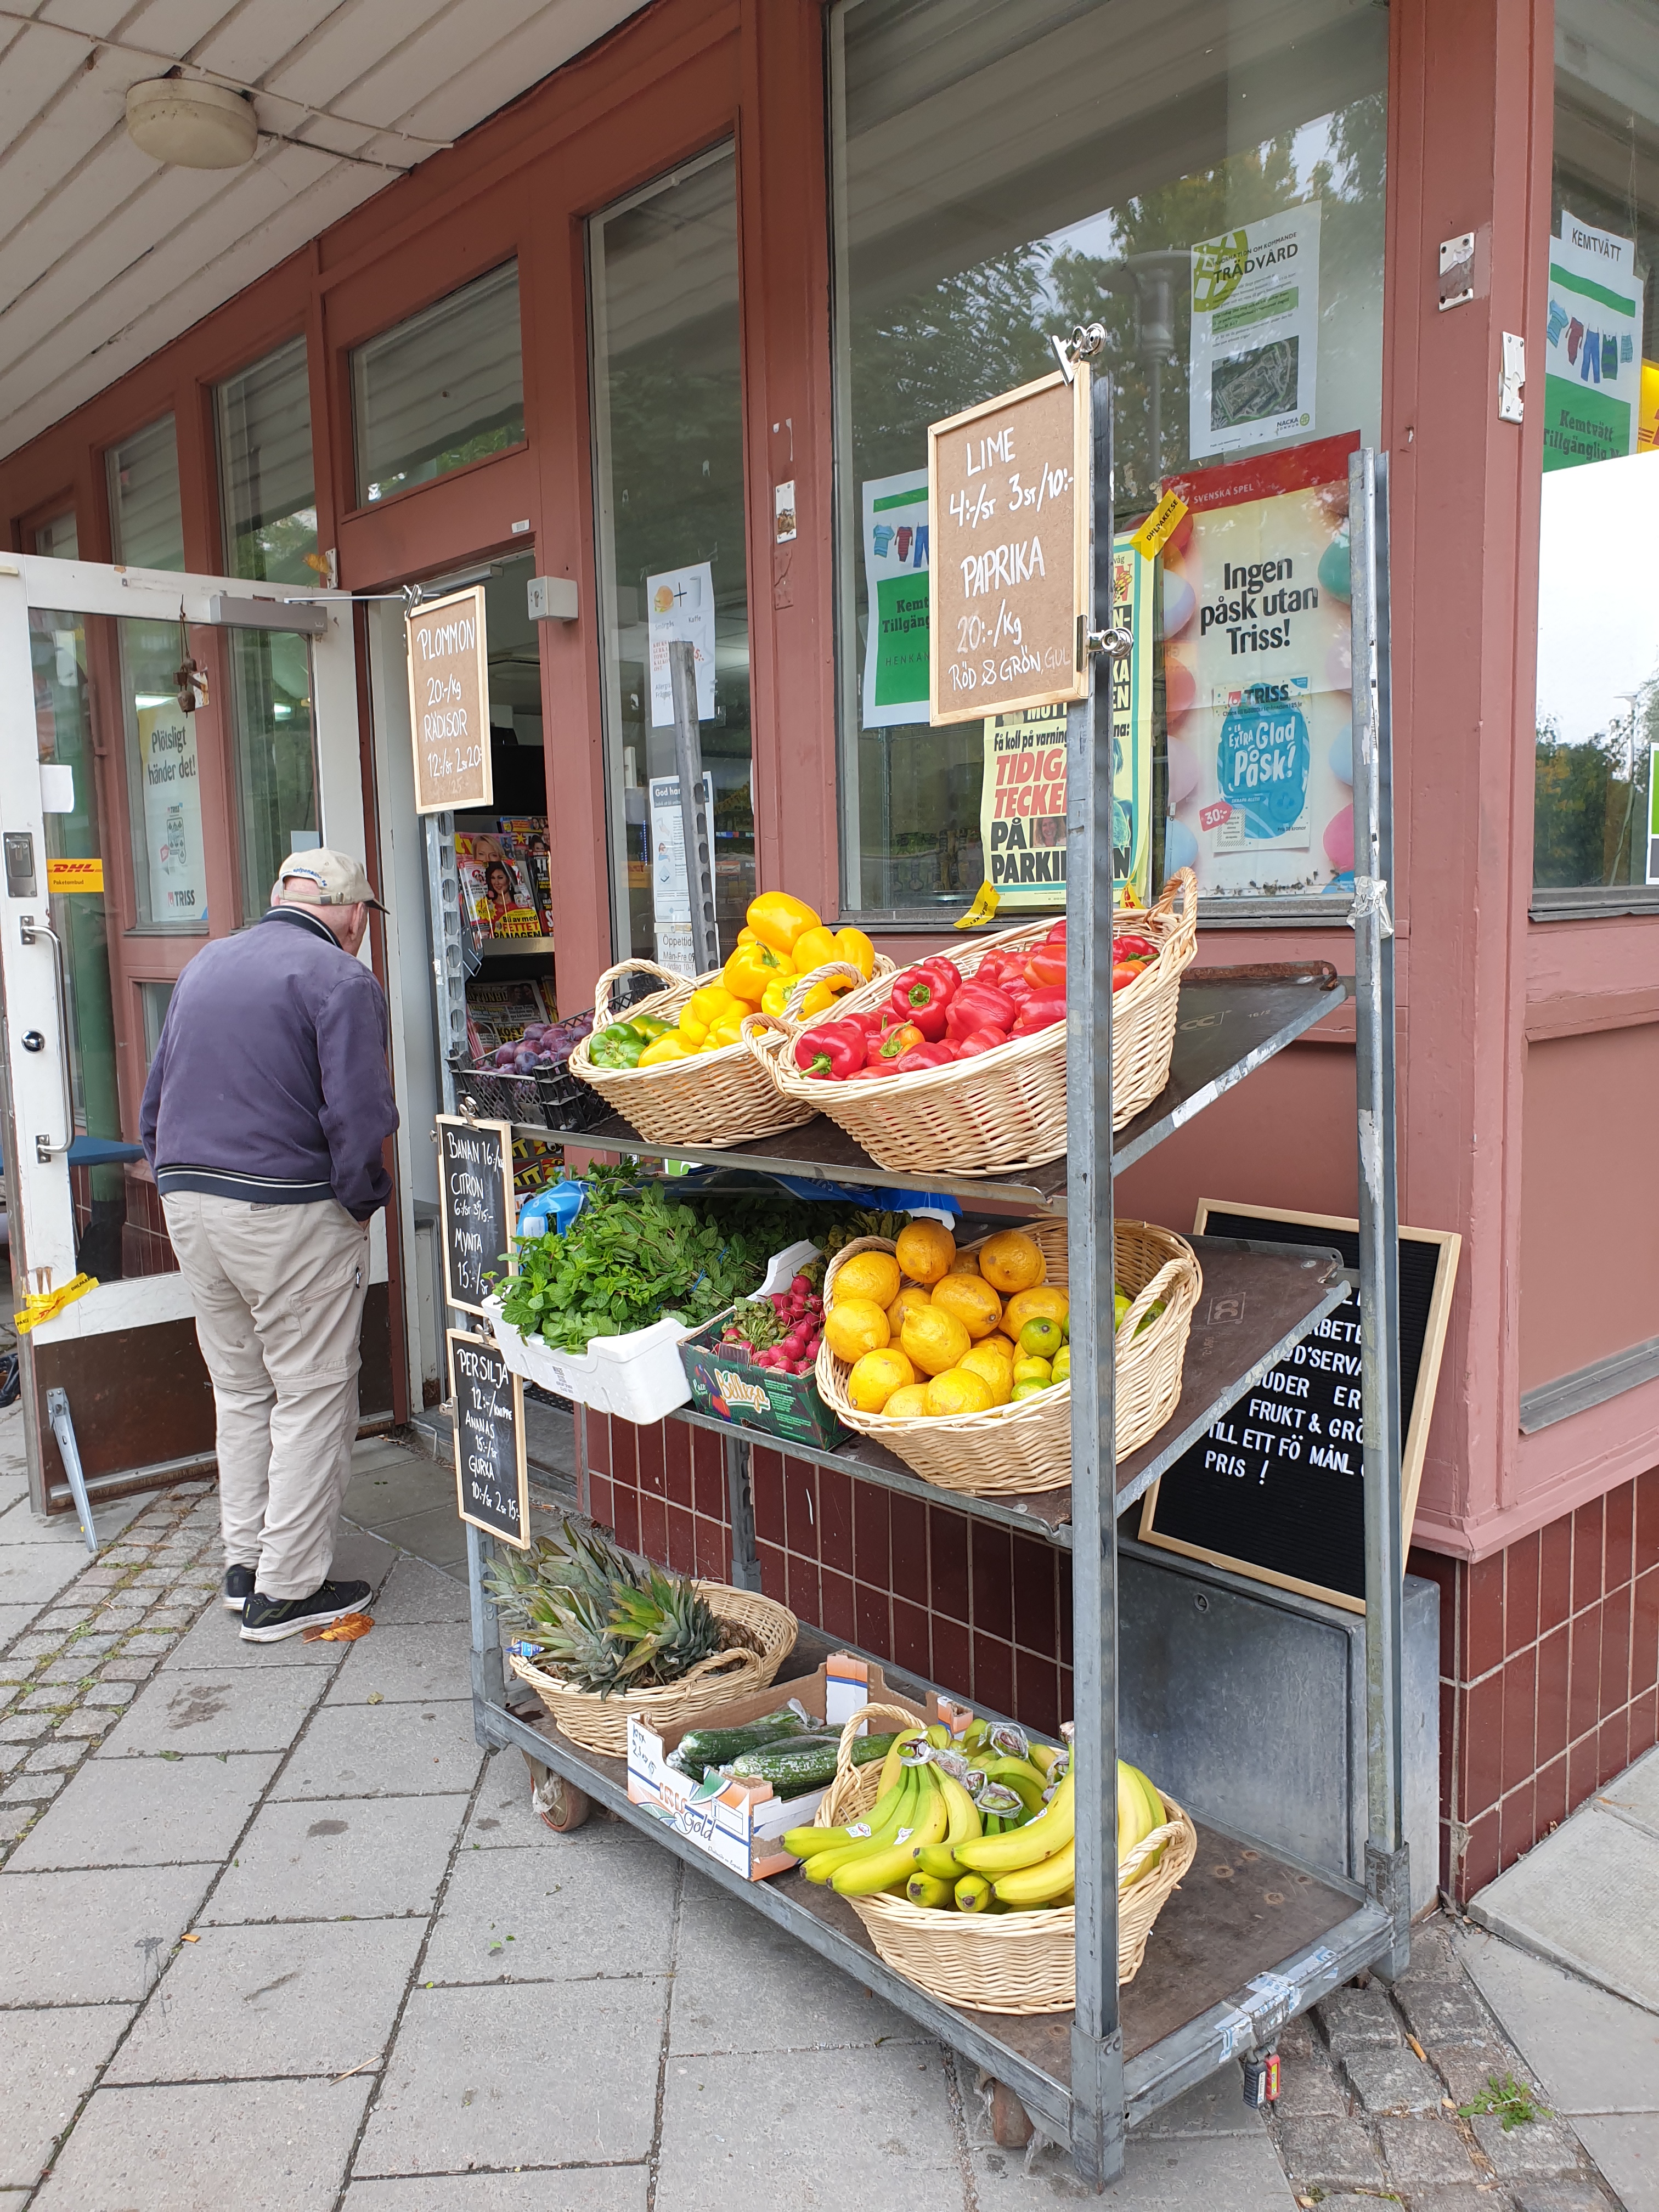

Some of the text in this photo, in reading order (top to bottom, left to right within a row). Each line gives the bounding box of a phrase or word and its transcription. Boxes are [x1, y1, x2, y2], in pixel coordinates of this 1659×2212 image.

[1253, 245, 1263, 253] OM
[1264, 232, 1297, 249] KOMMANDE
[1572, 227, 1622, 262] KEMTVÄTT
[1213, 243, 1299, 284] TRÄDVÅRD
[1277, 417, 1299, 427] NACKA
[1560, 409, 1613, 442] Kemtvätt
[967, 426, 1016, 477] LIME
[1193, 483, 1254, 504] SVENSKA SPEL
[1146, 499, 1178, 542] DHLPAKET.SE
[960, 535, 1046, 598] PAPRIKA
[1223, 557, 1293, 595] Ingen
[688, 615, 702, 623] Kaffe
[896, 596, 929, 613] Kemt
[1200, 586, 1319, 636] påsk utan
[416, 616, 475, 661] PLOMMON
[882, 614, 930, 634] Tillgäng
[1226, 617, 1291, 655] Triss!
[948, 661, 977, 691] RÖD
[1044, 646, 1071, 669] GUL
[1244, 684, 1289, 706] TRISS
[151, 725, 187, 754] Plötsligt
[424, 708, 468, 743] RÄDISOR
[994, 731, 1003, 752] Få
[1005, 731, 1021, 751] koll
[1022, 729, 1034, 753] på
[1234, 724, 1242, 732] EN
[1255, 715, 1296, 750] Glad
[148, 754, 196, 786] händer det!
[996, 748, 1067, 786] TIDIG
[655, 787, 668, 797] God
[994, 782, 1067, 819] TECKE
[1204, 808, 1228, 825] 30:-
[991, 817, 1027, 851] PÅ
[53, 864, 95, 872] DHL
[174, 889, 195, 907] TRISS
[503, 921, 539, 933] FETTET
[663, 933, 693, 949] Öppettid
[663, 951, 687, 961] Mån-Fre
[447, 1131, 481, 1165] BANAN
[450, 1172, 484, 1200] CITRON
[454, 1228, 483, 1257] MYNTA
[71, 1277, 90, 1291] DHLPAK
[456, 1347, 510, 1390] PERSILJA
[715, 1368, 770, 1413] Belleza
[465, 1408, 495, 1440] ANANAS
[1208, 1420, 1238, 1445] TILL
[1242, 1427, 1276, 1454] ETT
[1249, 1398, 1363, 1444] FRUKT & GRÖ
[469, 1454, 495, 1481] GURKA
[1204, 1450, 1246, 1478] PRIS
[659, 1781, 687, 1814] IRIS
[681, 1810, 716, 1842] Gold
